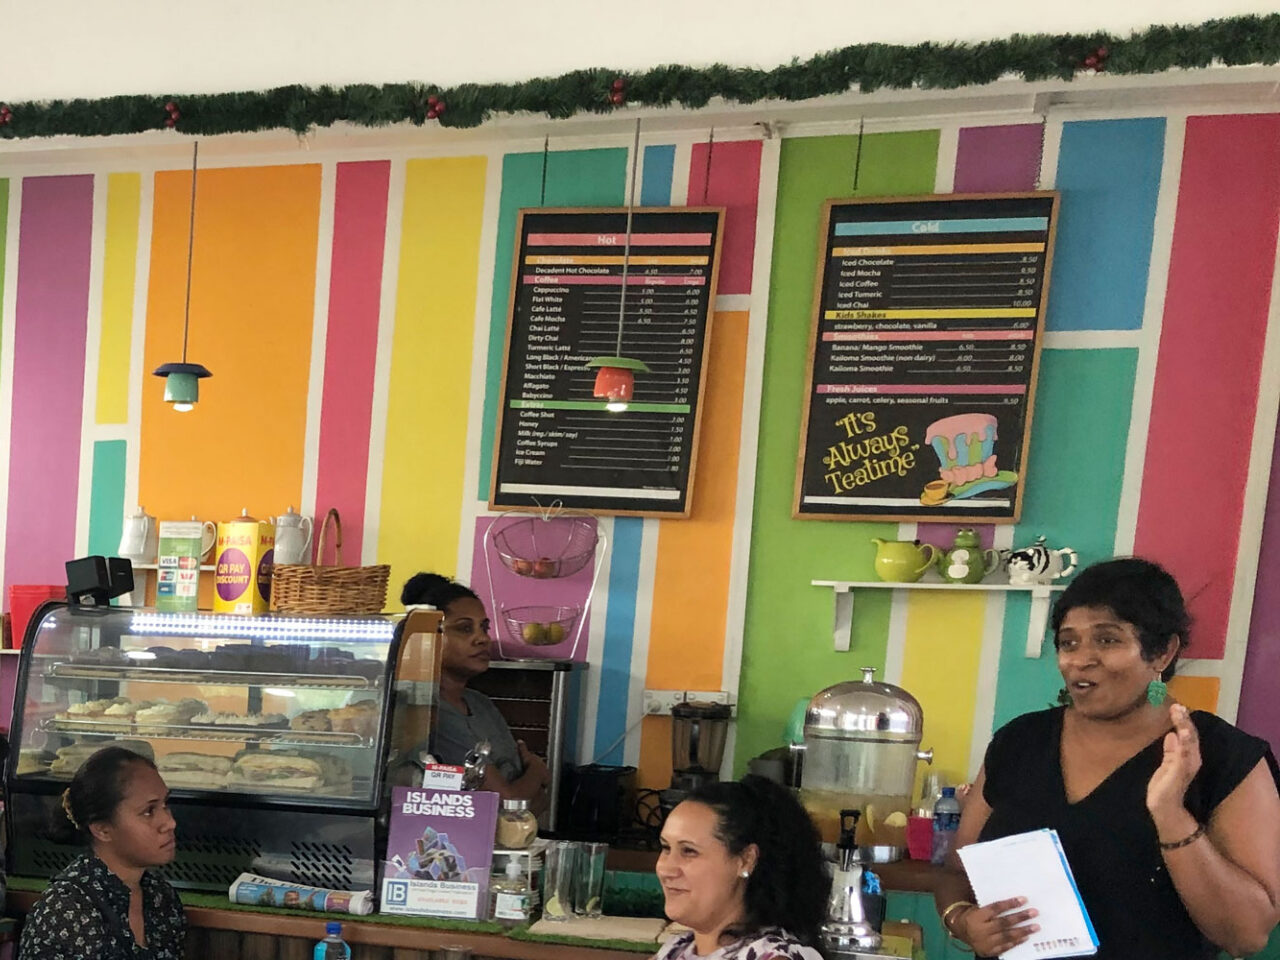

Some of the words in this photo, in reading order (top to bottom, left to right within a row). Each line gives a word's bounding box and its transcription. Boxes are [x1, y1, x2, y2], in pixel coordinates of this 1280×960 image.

[912, 222, 939, 232] Cold
[598, 236, 616, 245] Hot
[534, 276, 559, 284] Coffee
[834, 322, 874, 330] strawberry,
[862, 344, 887, 352] Mango
[526, 354, 542, 362] Long
[827, 385, 850, 393] Fresh
[851, 385, 877, 393] Juices
[873, 397, 895, 405] celery,
[823, 426, 909, 471] Always
[219, 563, 228, 574] QR
[229, 563, 245, 574] PAY
[216, 575, 249, 584] DISCOUNT
[407, 791, 473, 806] ISLANDS
[402, 802, 475, 818] BUSINESS
[410, 881, 438, 889] Islands
[440, 882, 476, 891] Business
[387, 883, 406, 902] IB
